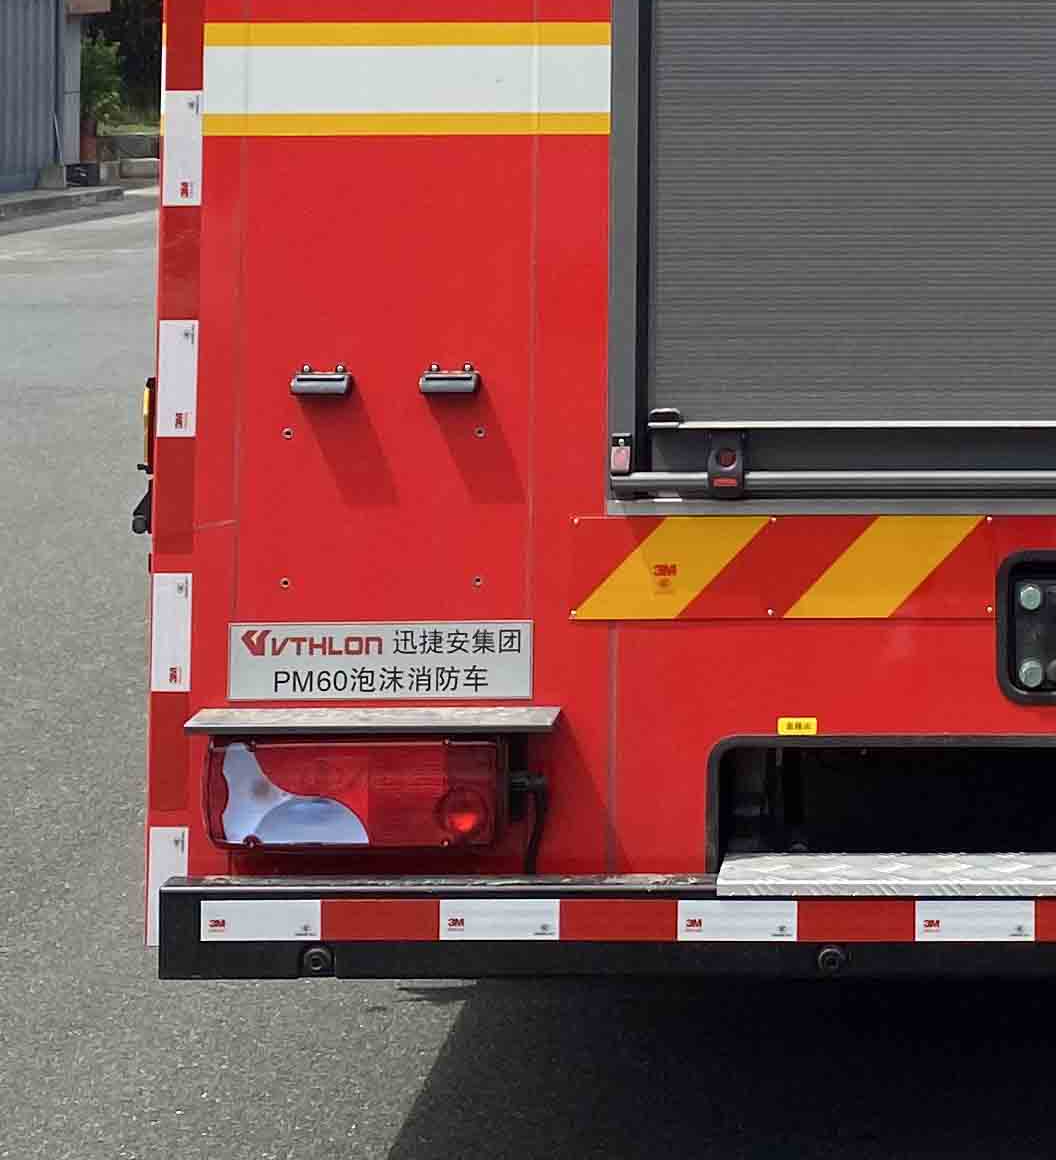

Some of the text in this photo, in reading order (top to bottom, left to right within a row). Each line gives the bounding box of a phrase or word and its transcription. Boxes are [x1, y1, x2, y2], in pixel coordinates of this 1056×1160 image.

[654, 564, 677, 576] 3M
[271, 629, 522, 656] VTHLON 迅捷安集团
[273, 666, 490, 693] PM60泡沫消防车
[208, 919, 225, 928] 3M
[448, 917, 464, 927] 3M
[686, 918, 702, 928] 3M
[924, 919, 940, 928] 3M
